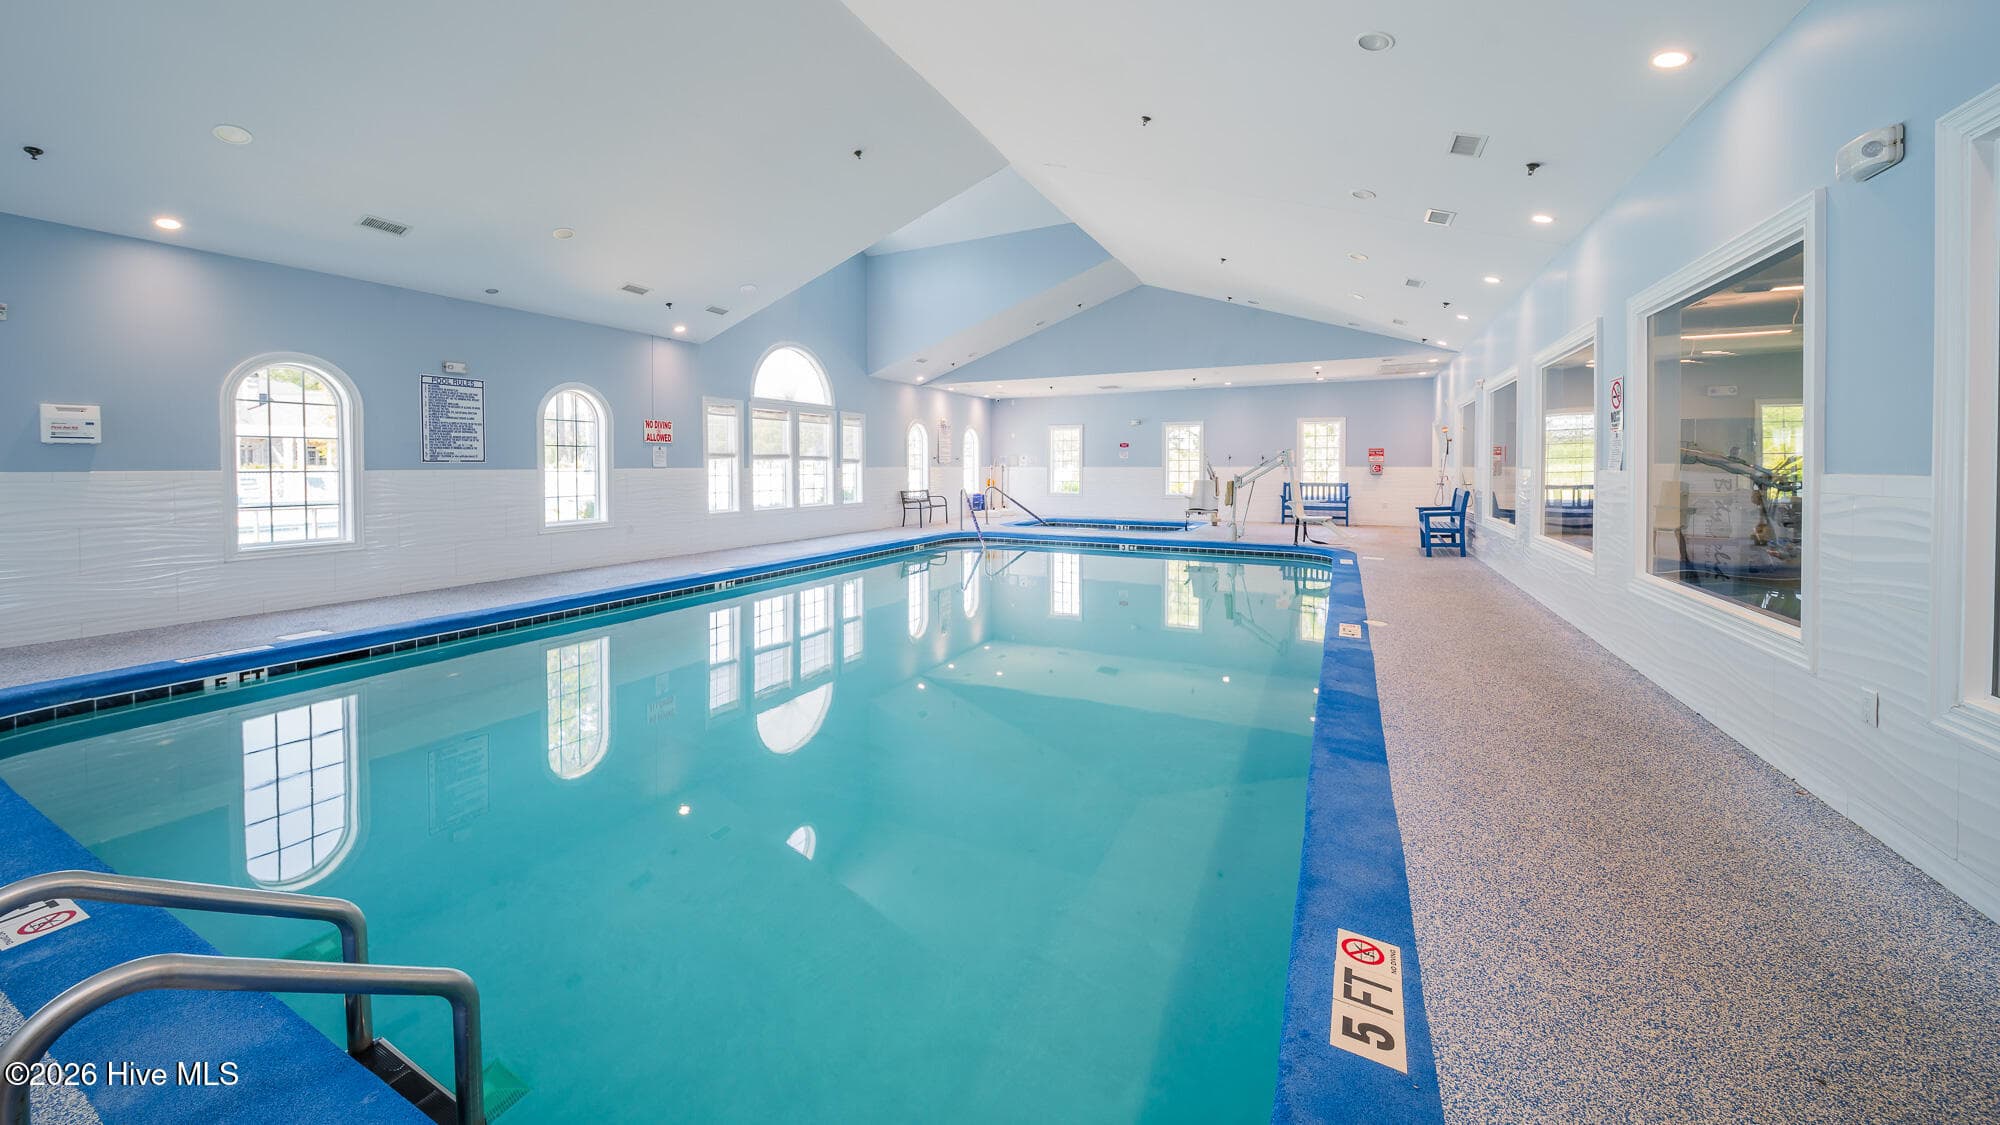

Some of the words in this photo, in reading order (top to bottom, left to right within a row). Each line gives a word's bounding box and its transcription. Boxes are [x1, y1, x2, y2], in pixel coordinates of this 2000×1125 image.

[432, 377, 450, 385] POOL
[453, 379, 475, 387] RULES
[645, 420, 654, 429] NO
[655, 420, 672, 429] DIVING
[646, 433, 672, 442] ALLOWED
[1391, 966, 1397, 975] NO
[1343, 966, 1393, 1015] FT
[1342, 1015, 1395, 1051] 5
